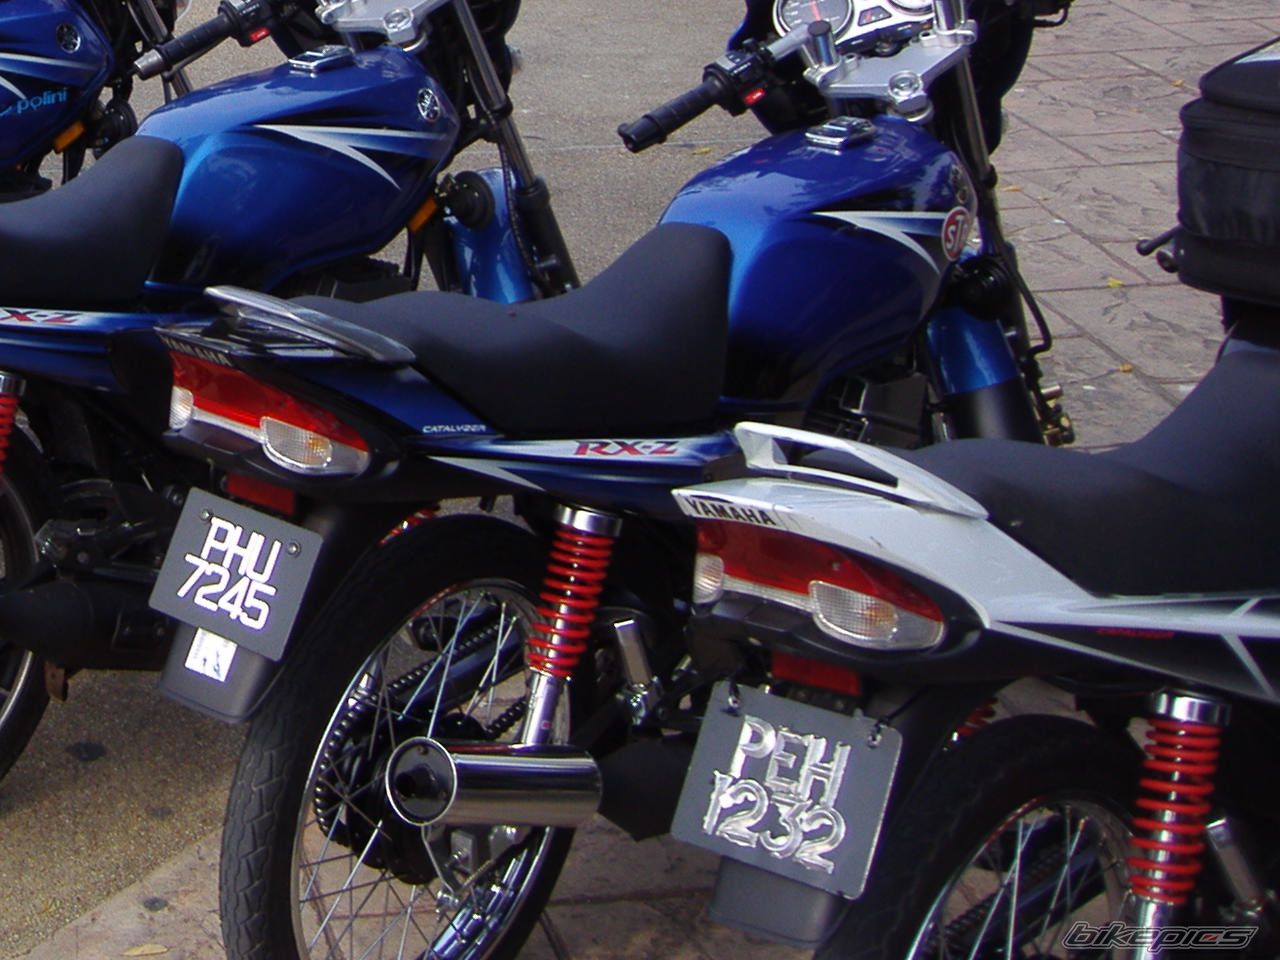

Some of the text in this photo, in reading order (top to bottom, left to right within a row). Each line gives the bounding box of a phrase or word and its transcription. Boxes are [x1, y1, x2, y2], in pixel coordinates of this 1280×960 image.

[17, 88, 66, 114] polini
[423, 424, 486, 433] CATALYZER
[573, 440, 679, 456] RX-Z
[684, 497, 776, 526] YAMAHA
[201, 516, 282, 584] PHU
[177, 553, 277, 630] 7245
[730, 714, 852, 808] PEH
[703, 770, 846, 874] 1232
